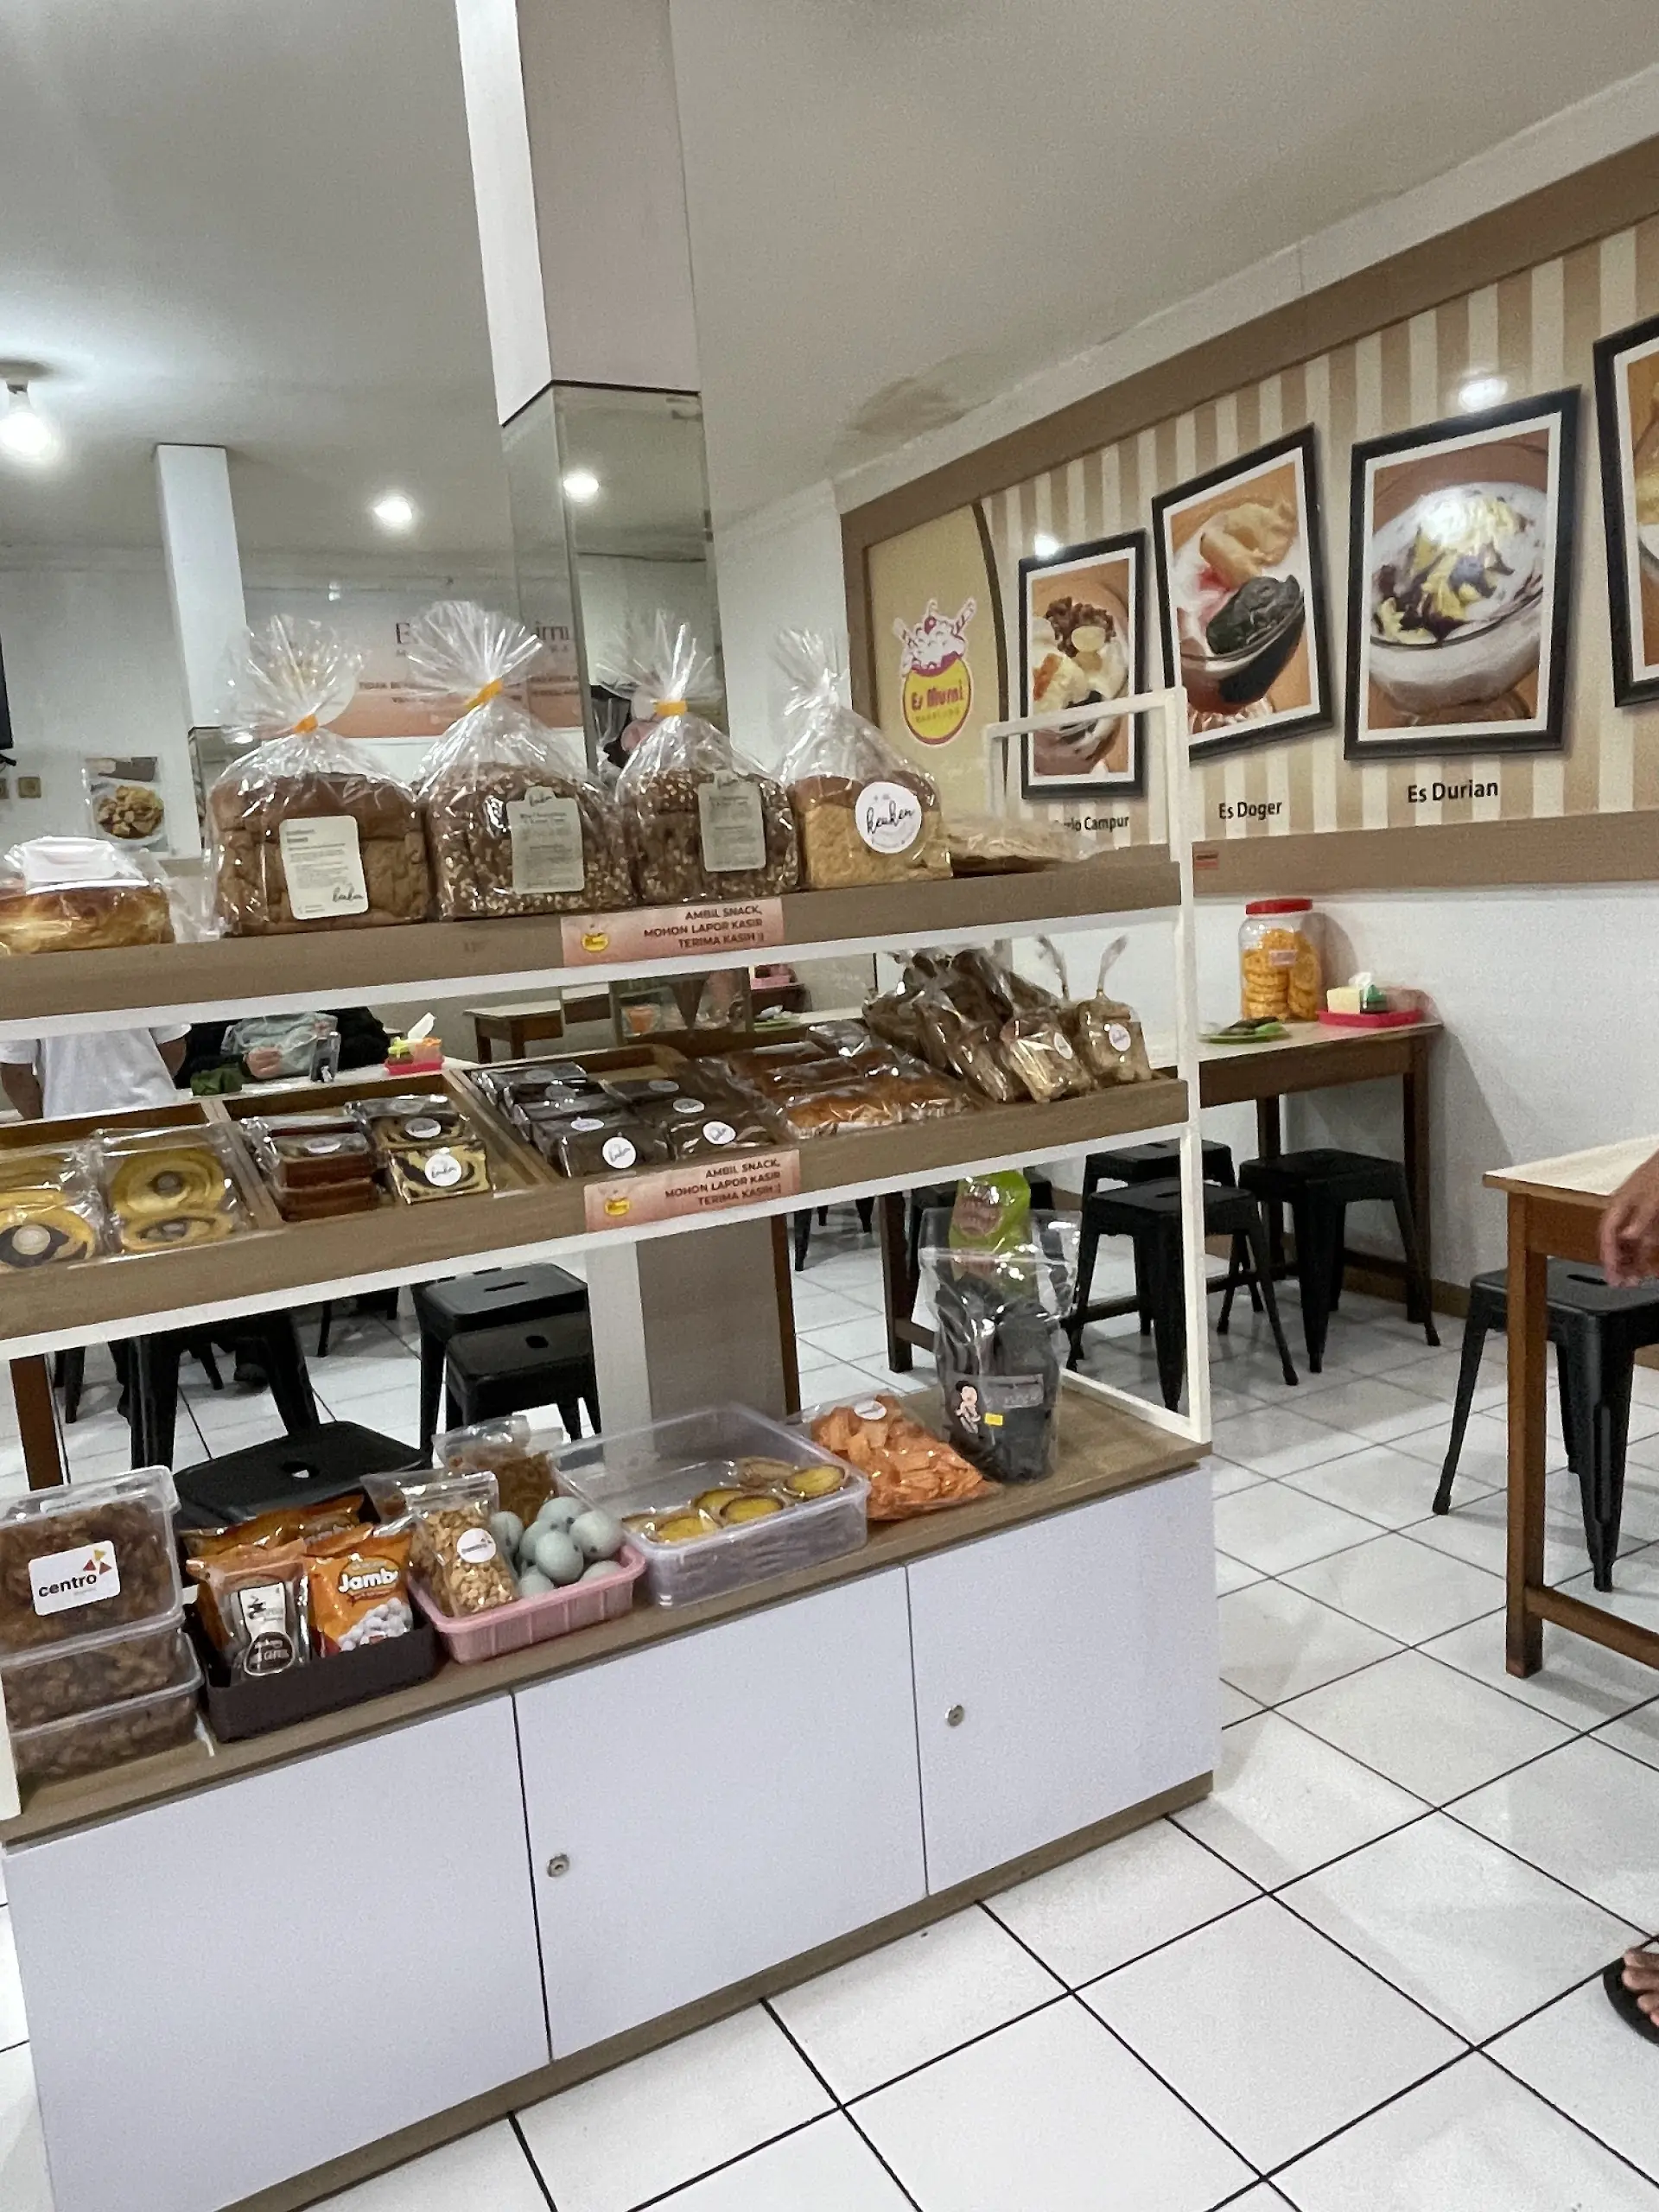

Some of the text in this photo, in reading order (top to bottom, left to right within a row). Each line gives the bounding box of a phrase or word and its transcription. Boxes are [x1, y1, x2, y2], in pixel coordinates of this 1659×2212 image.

[1408, 779, 1498, 803] Es Durian
[1218, 802, 1282, 821] Es Doger
[1084, 816, 1129, 833] Campur
[685, 908, 720, 920] AMBIL
[644, 918, 763, 938] MOHON LAPOR KASIR
[678, 936, 721, 949] TERIMA
[723, 932, 755, 944] KASIH
[705, 1165, 739, 1179] AMBIL
[664, 1171, 781, 1198] MOHON LAPOR KASIR
[698, 1192, 740, 1206] TERIMA
[741, 1185, 773, 1198] KASIH
[38, 1573, 97, 1597] centro
